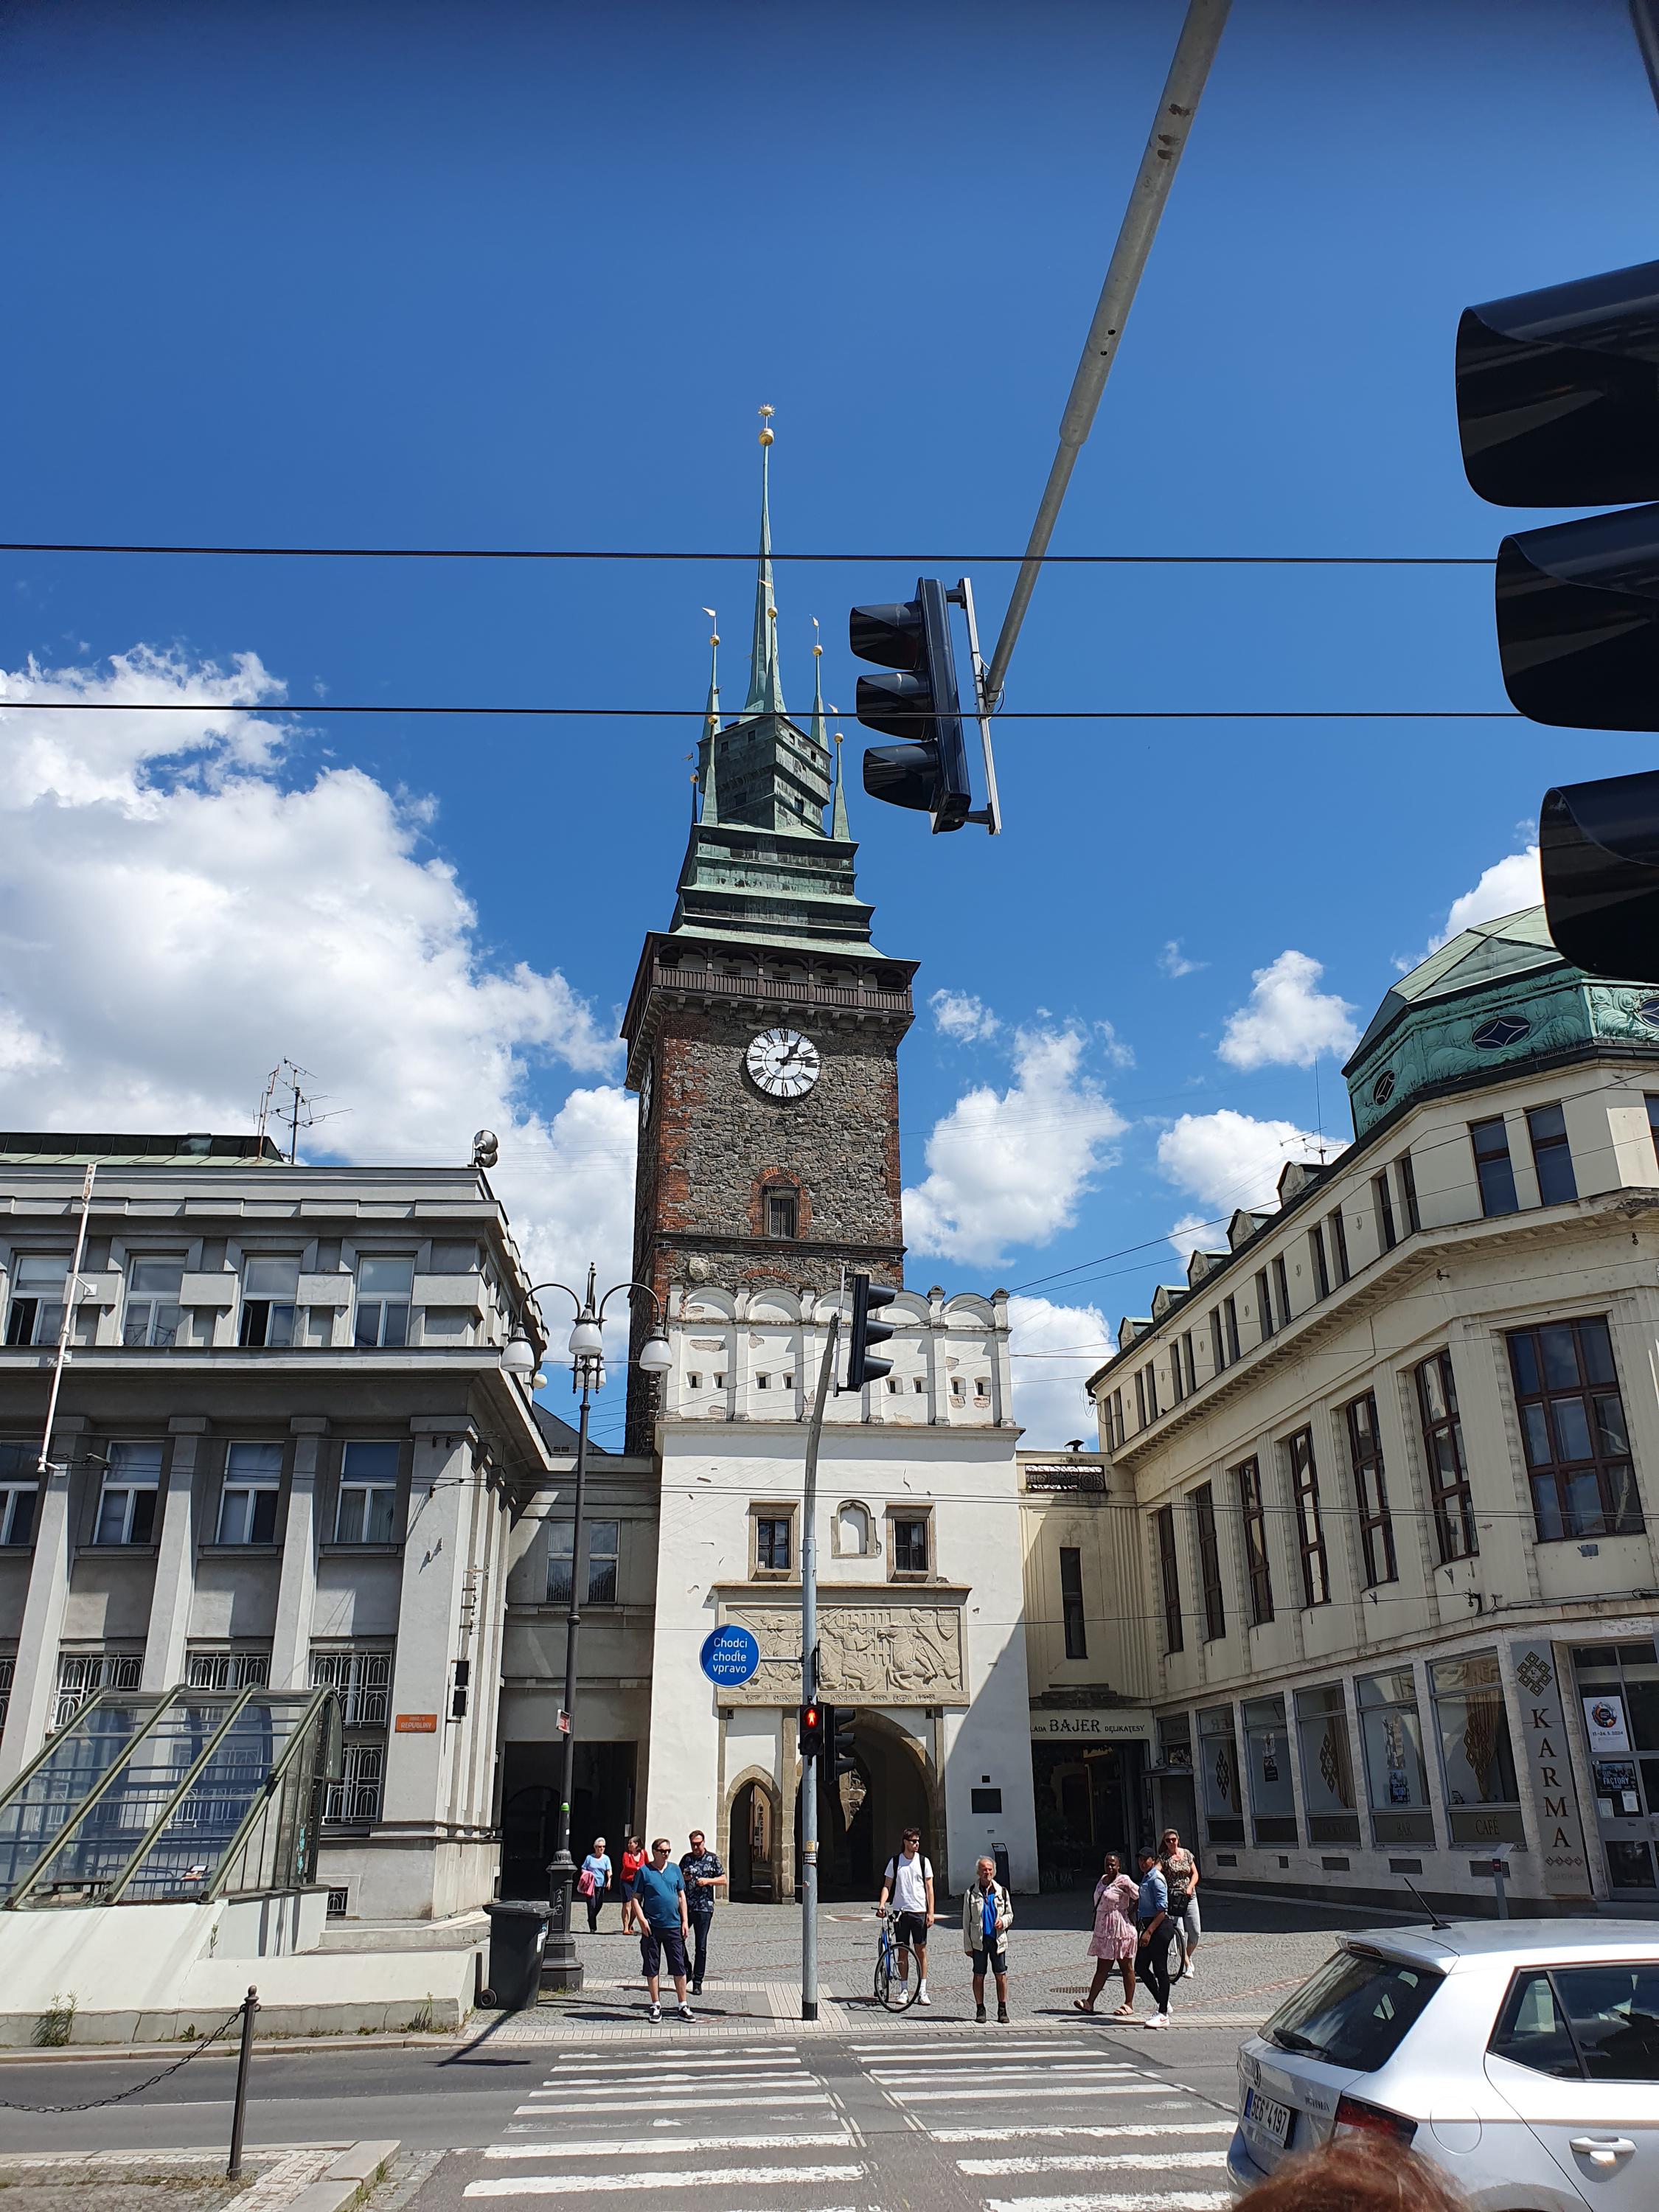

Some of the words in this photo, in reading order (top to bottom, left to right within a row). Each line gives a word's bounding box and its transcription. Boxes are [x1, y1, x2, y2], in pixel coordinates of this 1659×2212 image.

[779, 1030, 788, 1043] XII
[713, 1637, 748, 1648] Chodci
[712, 1664, 747, 1675] vpravo
[1049, 1719, 1101, 1733] BAJER
[1105, 1724, 1145, 1733] DELIKATESY
[1531, 1708, 1571, 1848] KARMA
[1602, 1777, 1629, 1785] FACTORY
[1397, 1822, 1415, 1836] BAR
[1475, 1816, 1500, 1835] CAFÉ
[1267, 2104, 1287, 2135] 4197
